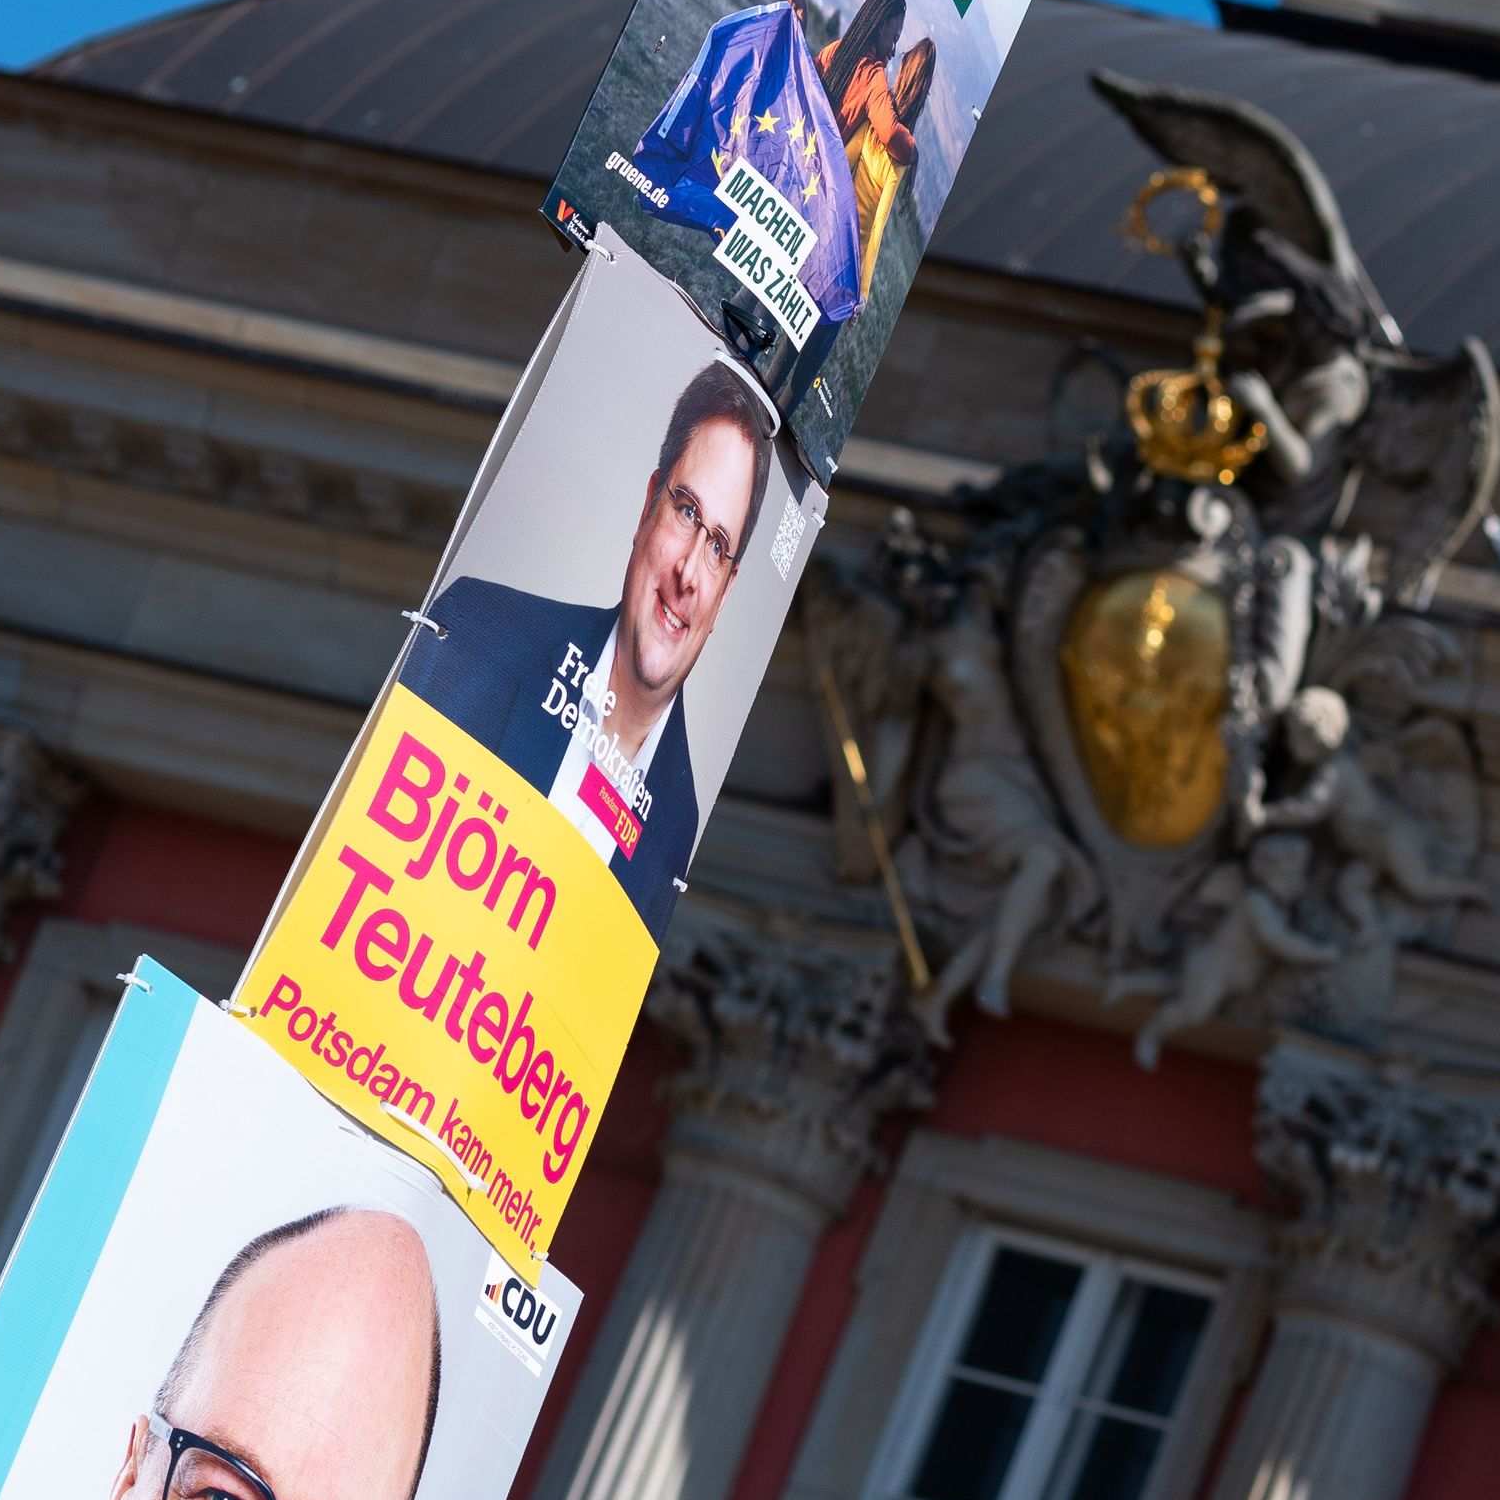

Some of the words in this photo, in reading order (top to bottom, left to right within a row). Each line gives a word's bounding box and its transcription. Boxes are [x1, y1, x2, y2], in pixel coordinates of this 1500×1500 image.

[604, 150, 671, 209] gruene.de
[724, 168, 806, 266] MACHEN,
[723, 227, 773, 284] WAS
[763, 268, 813, 340] ZÄHLT.
[557, 641, 617, 717] Free
[541, 677, 653, 822] Demokraten
[366, 730, 558, 952] Björn
[614, 809, 638, 849] FDP
[319, 844, 591, 1184] Teuteberg
[259, 973, 436, 1126] Potsdam
[437, 1097, 493, 1182] kann
[486, 1167, 543, 1252] mehr.
[501, 1277, 557, 1346] CDU
